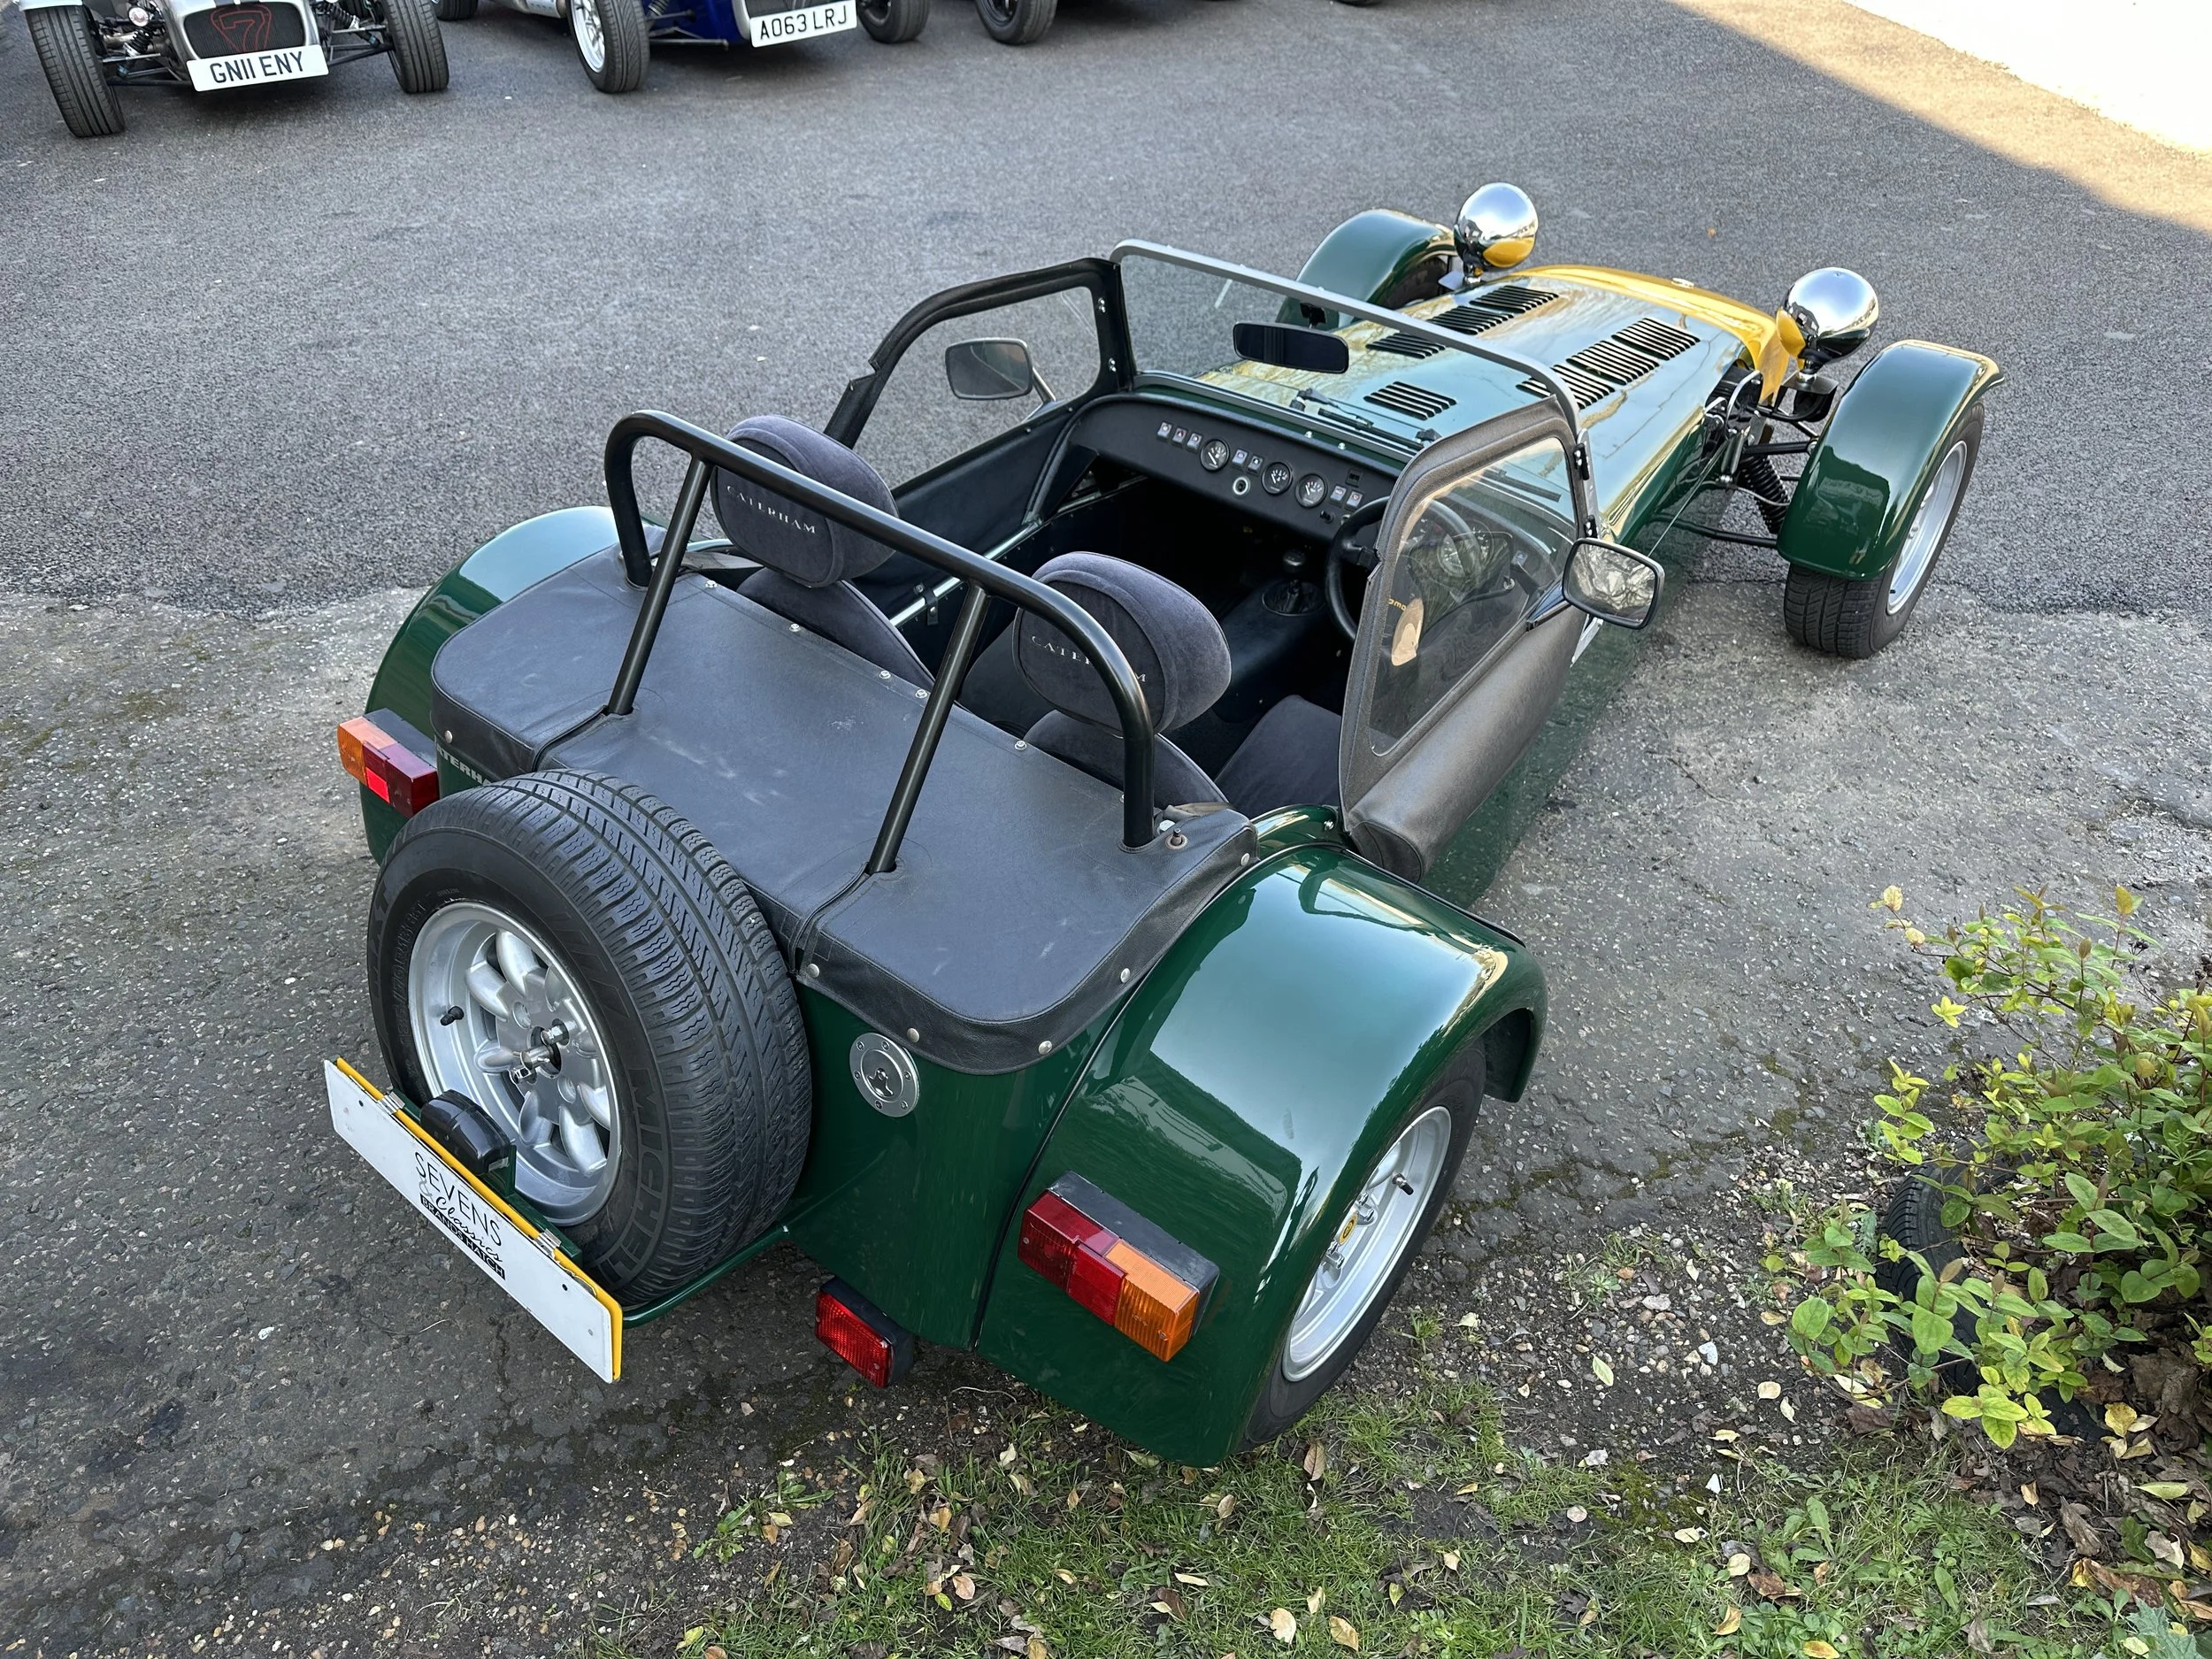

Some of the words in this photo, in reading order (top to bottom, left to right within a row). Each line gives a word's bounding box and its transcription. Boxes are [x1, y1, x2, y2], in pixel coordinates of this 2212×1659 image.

[813, 4, 847, 30] LRJ
[258, 50, 303, 77] ENY
[726, 485, 816, 534] CATERHAM
[414, 1151, 503, 1247] SEVENS
[420, 1196, 465, 1240] BRANDS
[465, 1239, 505, 1279] HATCH
[435, 1195, 503, 1263] Classics
